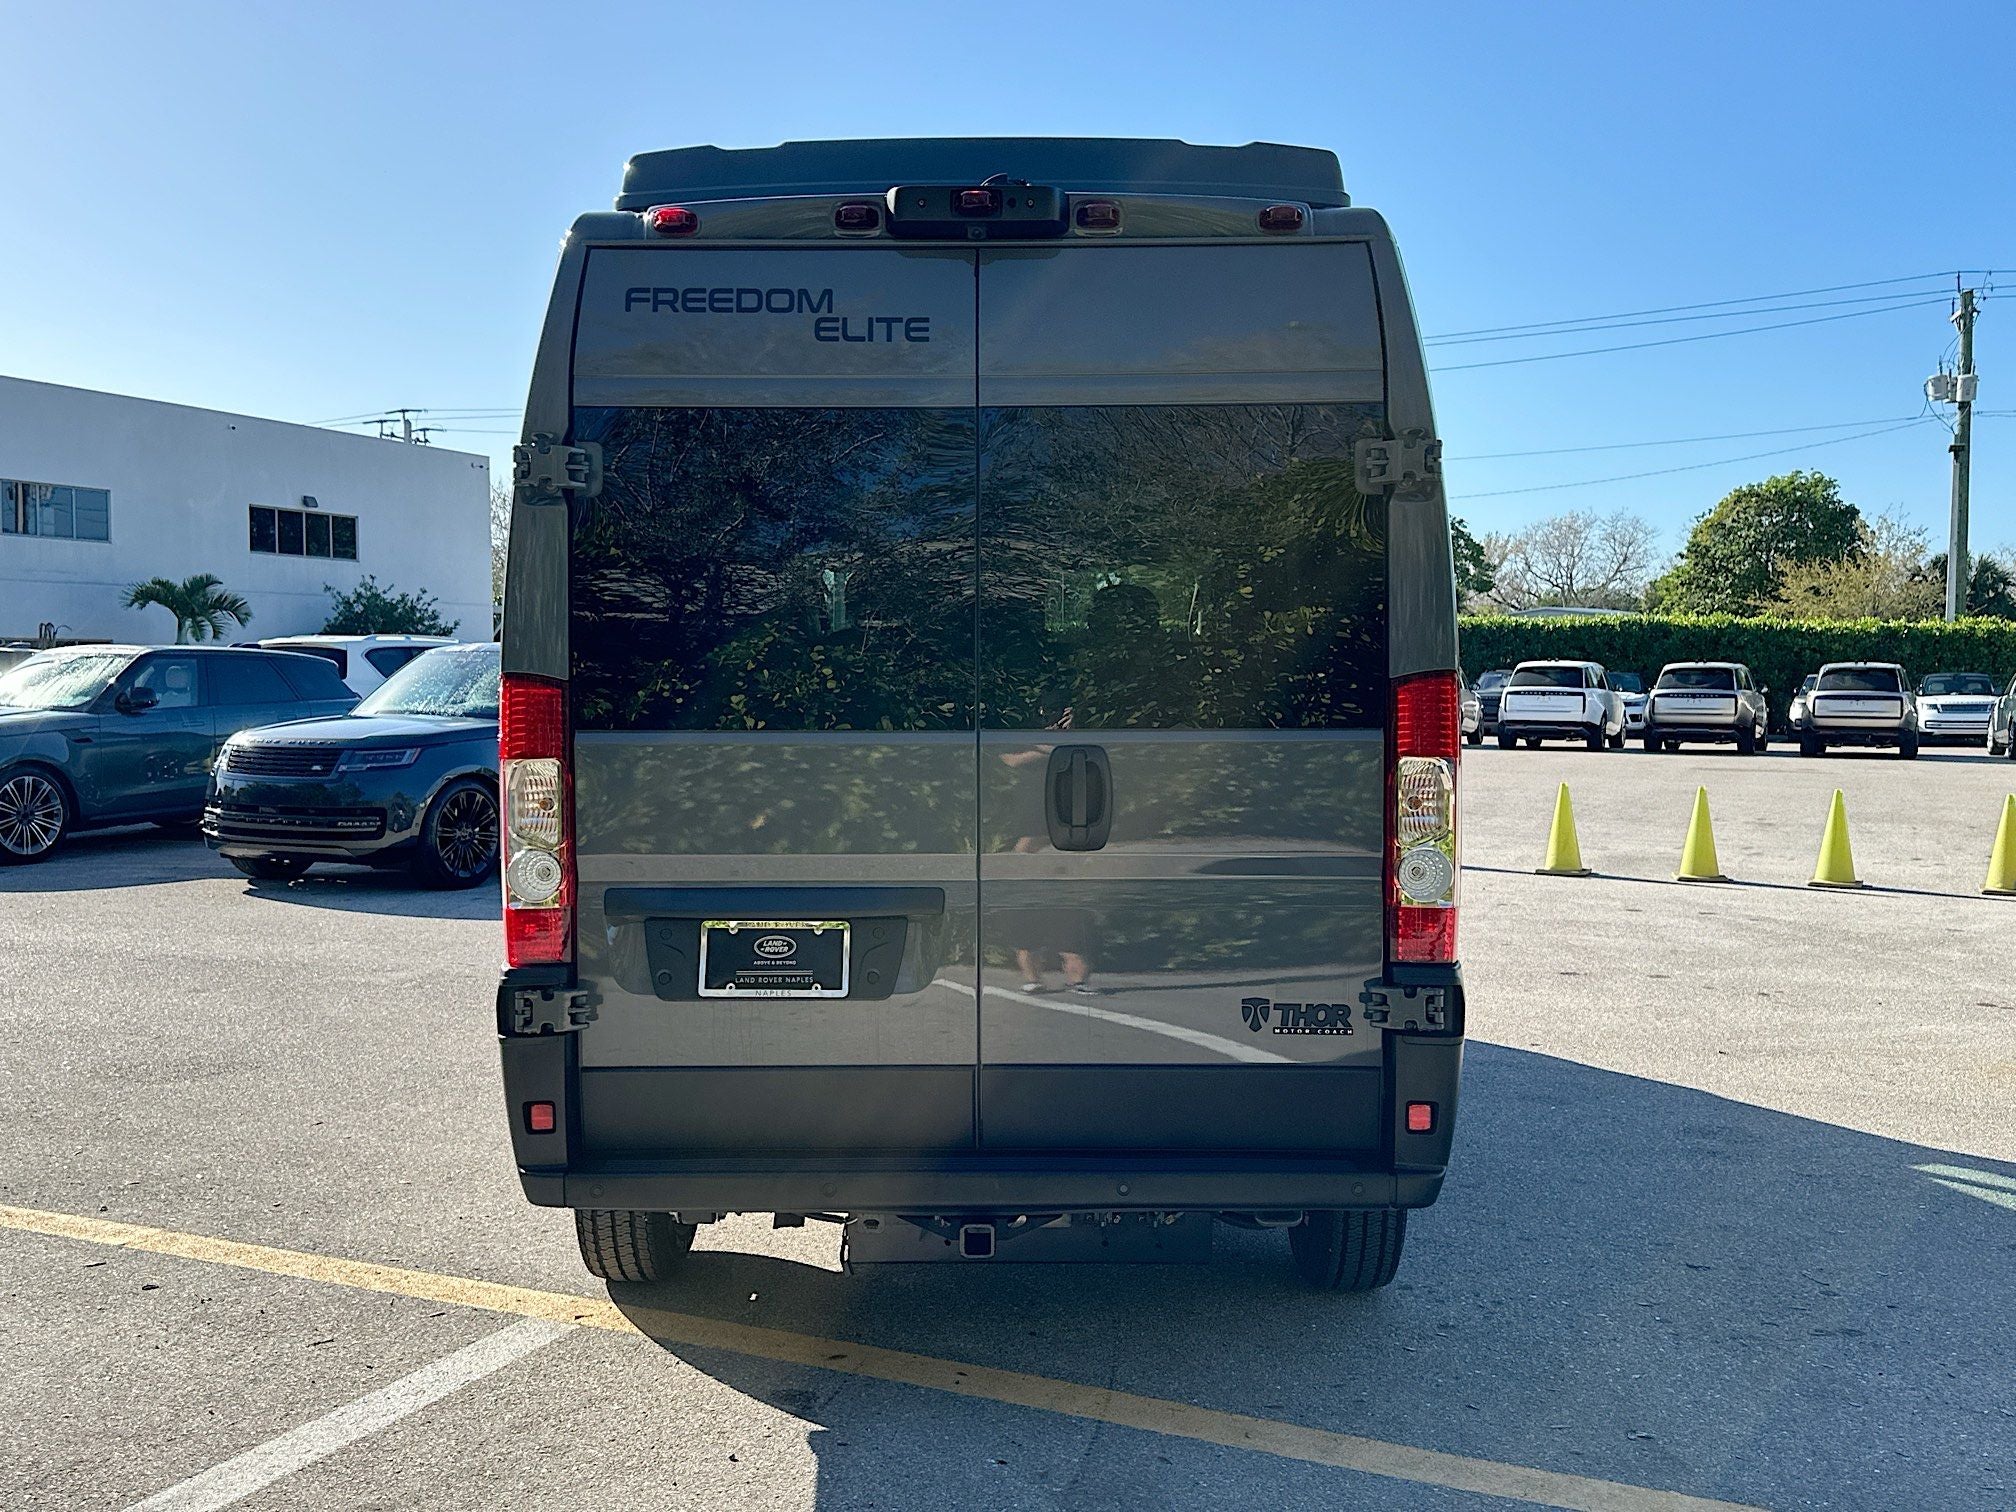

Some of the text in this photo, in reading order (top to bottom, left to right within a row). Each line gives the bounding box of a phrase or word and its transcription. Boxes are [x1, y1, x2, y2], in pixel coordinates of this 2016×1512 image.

[624, 287, 834, 314] FREEDOM
[814, 317, 930, 343] ELITE
[1273, 1003, 1352, 1027] THOR
